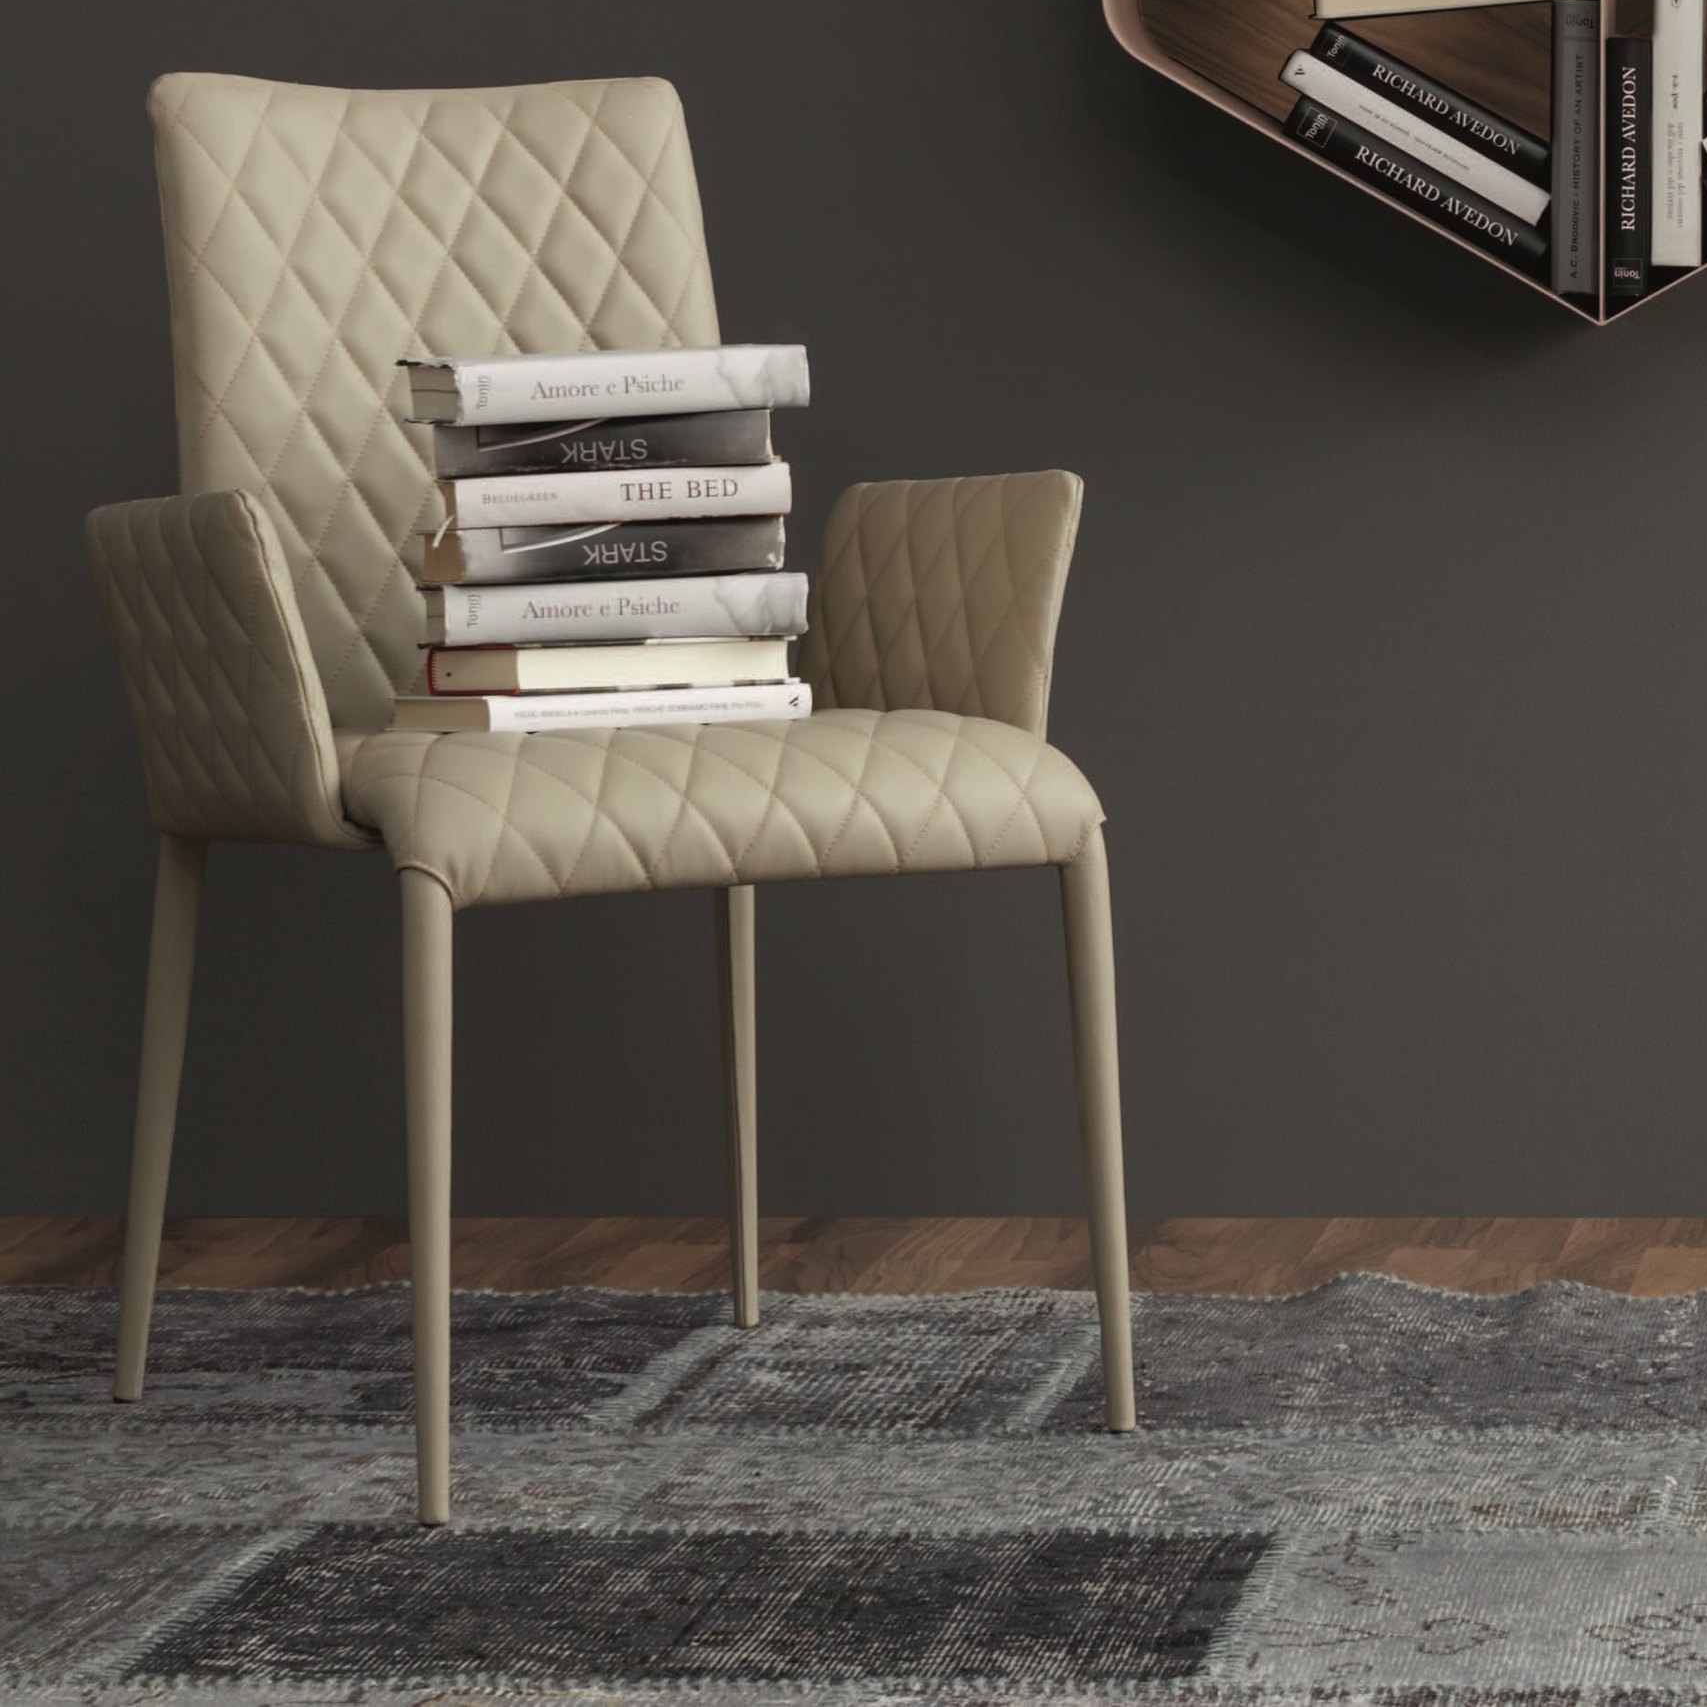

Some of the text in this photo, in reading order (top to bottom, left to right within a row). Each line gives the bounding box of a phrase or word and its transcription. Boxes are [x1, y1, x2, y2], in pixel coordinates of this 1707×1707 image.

[1574, 54, 1583, 95] ARTIST
[1371, 63, 1450, 115] RICHARD
[1448, 109, 1518, 155] AVEDON
[1574, 99, 1582, 115] AN
[1573, 118, 1582, 134] OF
[1621, 66, 1636, 229] RICHARD AVEDON
[1572, 137, 1581, 188] HISTORY
[1354, 145, 1518, 246] RICHARD AVEDON
[530, 379, 599, 399] Amore
[623, 373, 681, 394] Psiche
[560, 438, 647, 463] STARK
[620, 479, 738, 501] THE BED
[582, 540, 667, 565] STARK
[521, 599, 592, 619] Amore
[618, 595, 679, 615] Psiche
